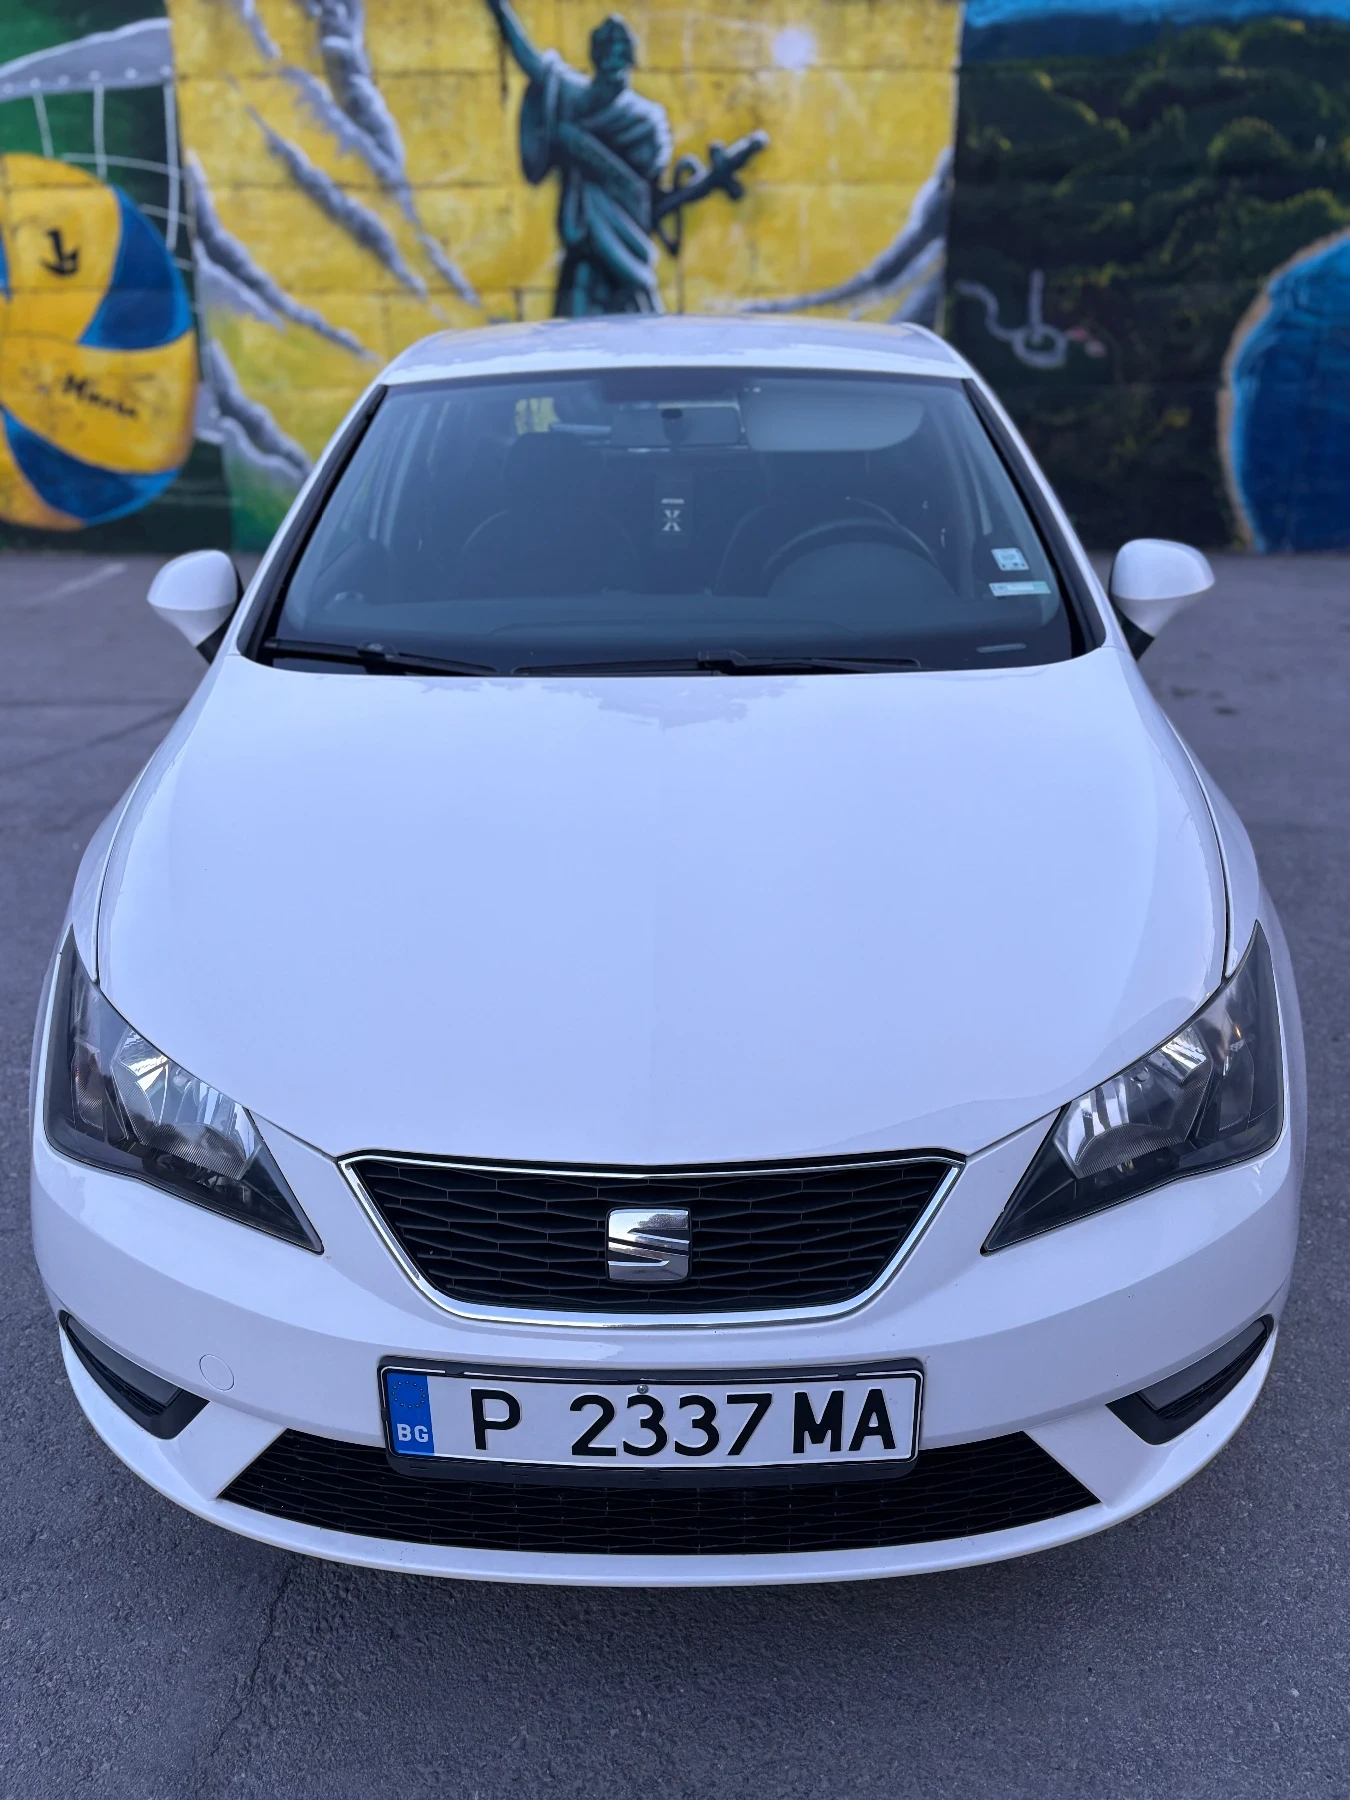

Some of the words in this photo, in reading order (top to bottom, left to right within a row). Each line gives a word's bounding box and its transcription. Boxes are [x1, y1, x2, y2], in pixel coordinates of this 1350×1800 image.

[396, 1423, 430, 1443] BG
[470, 1388, 522, 1450] P
[569, 1392, 773, 1457] 2337
[791, 1388, 897, 1454] MA
